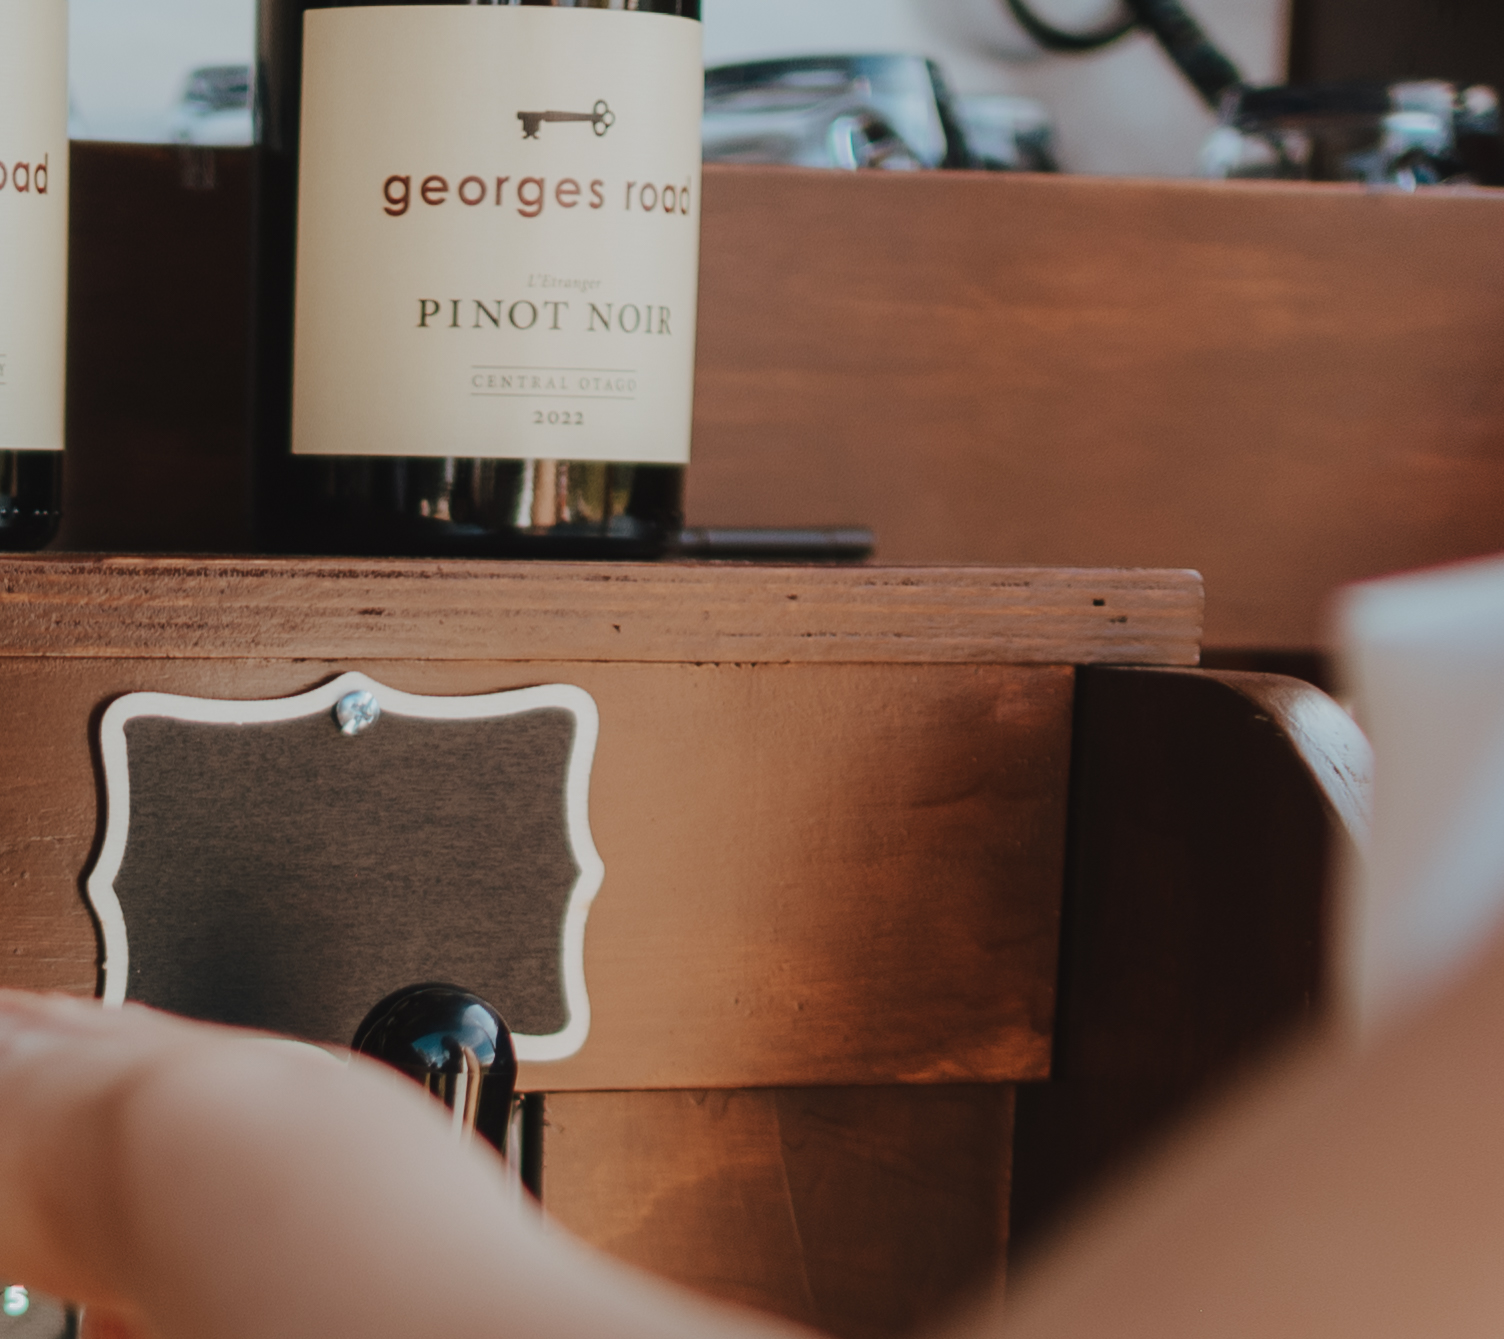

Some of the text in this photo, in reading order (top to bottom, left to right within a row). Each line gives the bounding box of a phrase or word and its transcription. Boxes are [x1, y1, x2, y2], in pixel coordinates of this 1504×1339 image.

[382, 175, 605, 218] georges
[416, 298, 673, 336] PINOT NOIR
[471, 374, 569, 390] CENTRAL
[533, 410, 585, 426] 2022
[3, 1284, 28, 1316] 5
